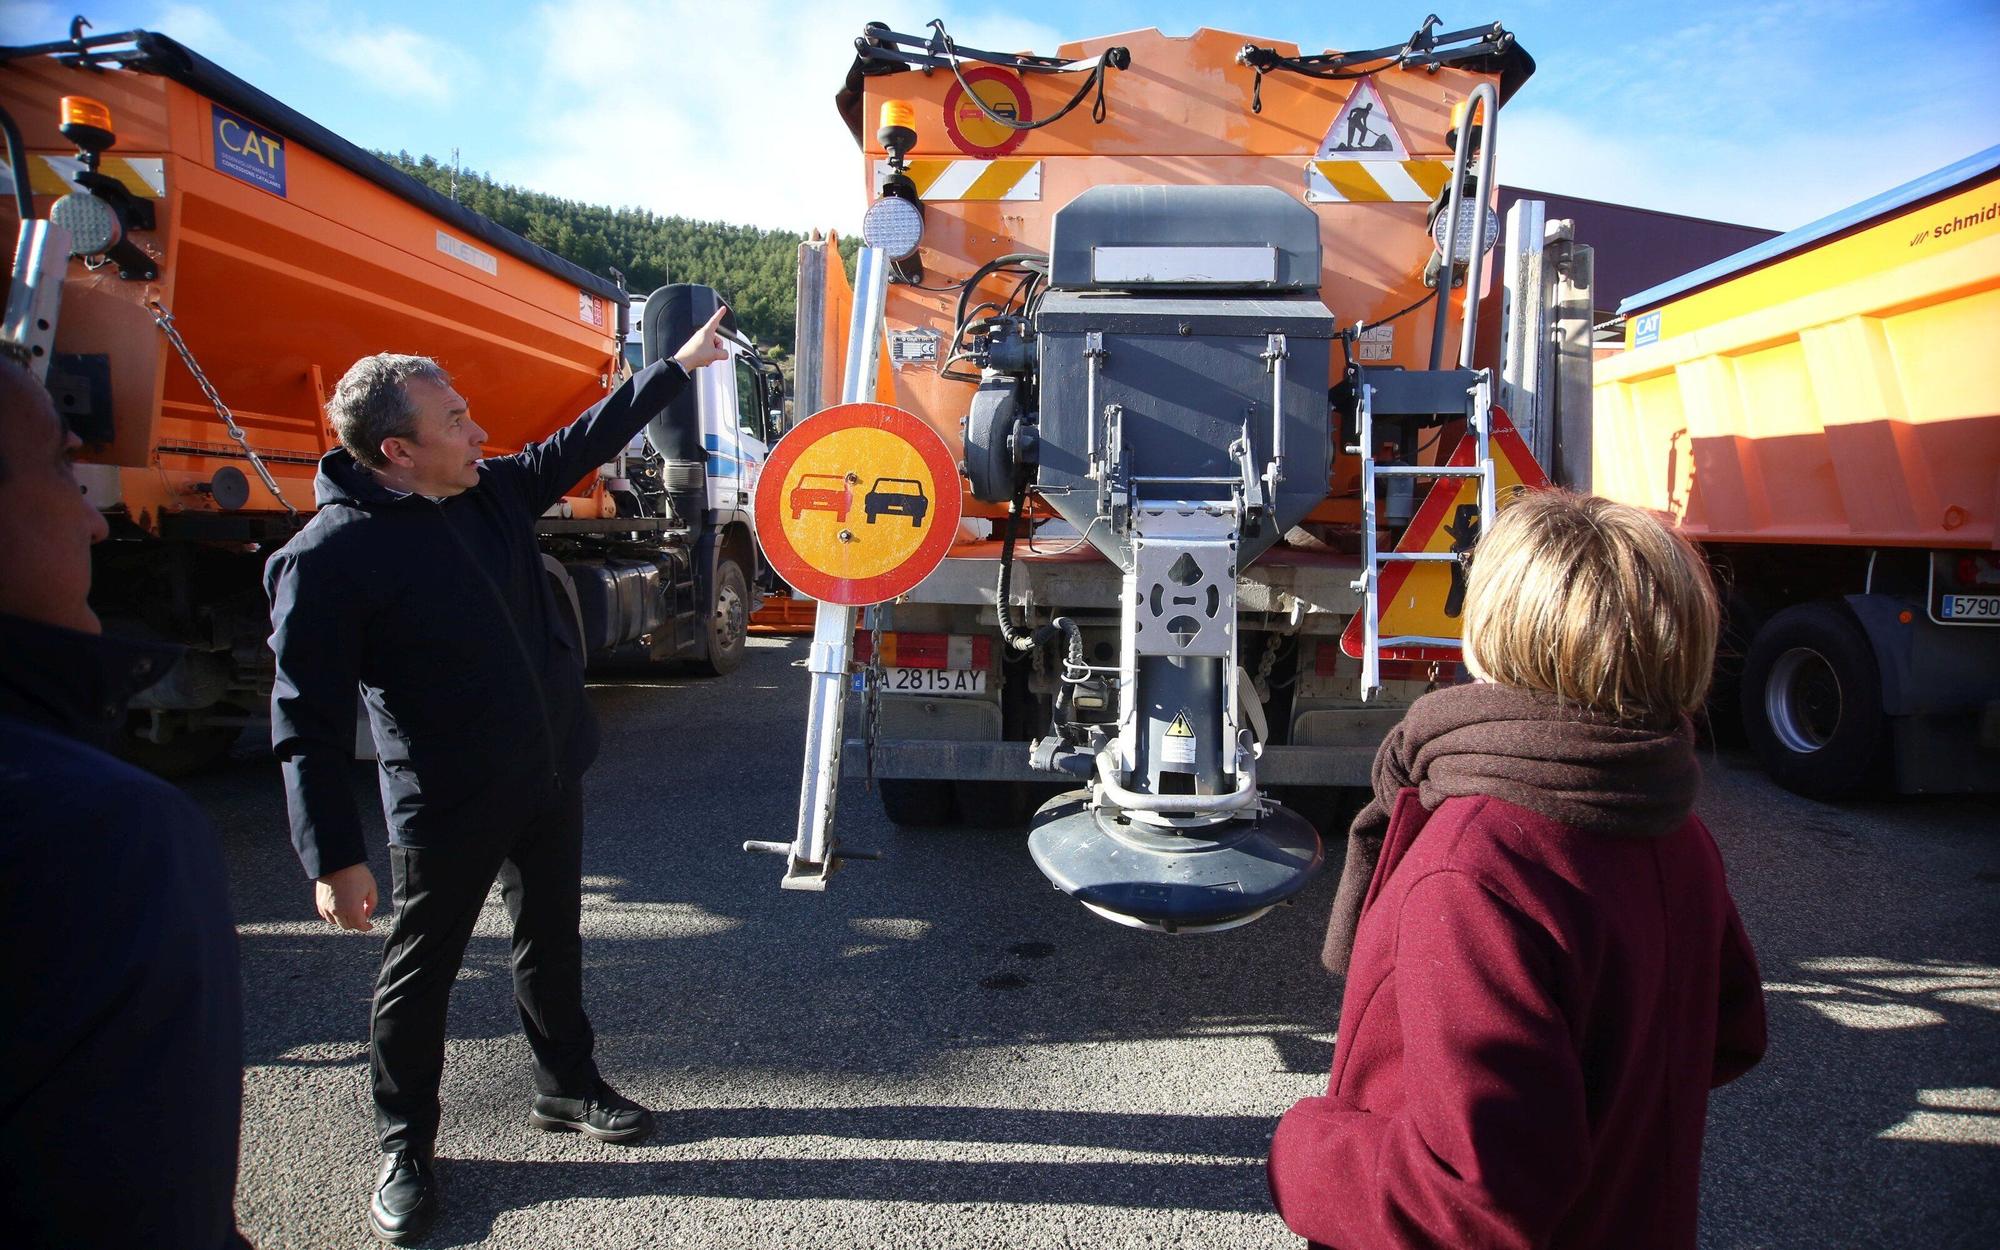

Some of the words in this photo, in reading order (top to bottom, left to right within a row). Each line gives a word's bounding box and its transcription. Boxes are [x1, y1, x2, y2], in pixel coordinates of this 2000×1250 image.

[219, 118, 280, 169] CAT
[1637, 313, 1660, 336] CAT
[1954, 597, 2000, 616] 5790
[896, 668, 950, 690] 2815
[955, 669, 981, 691] AY
